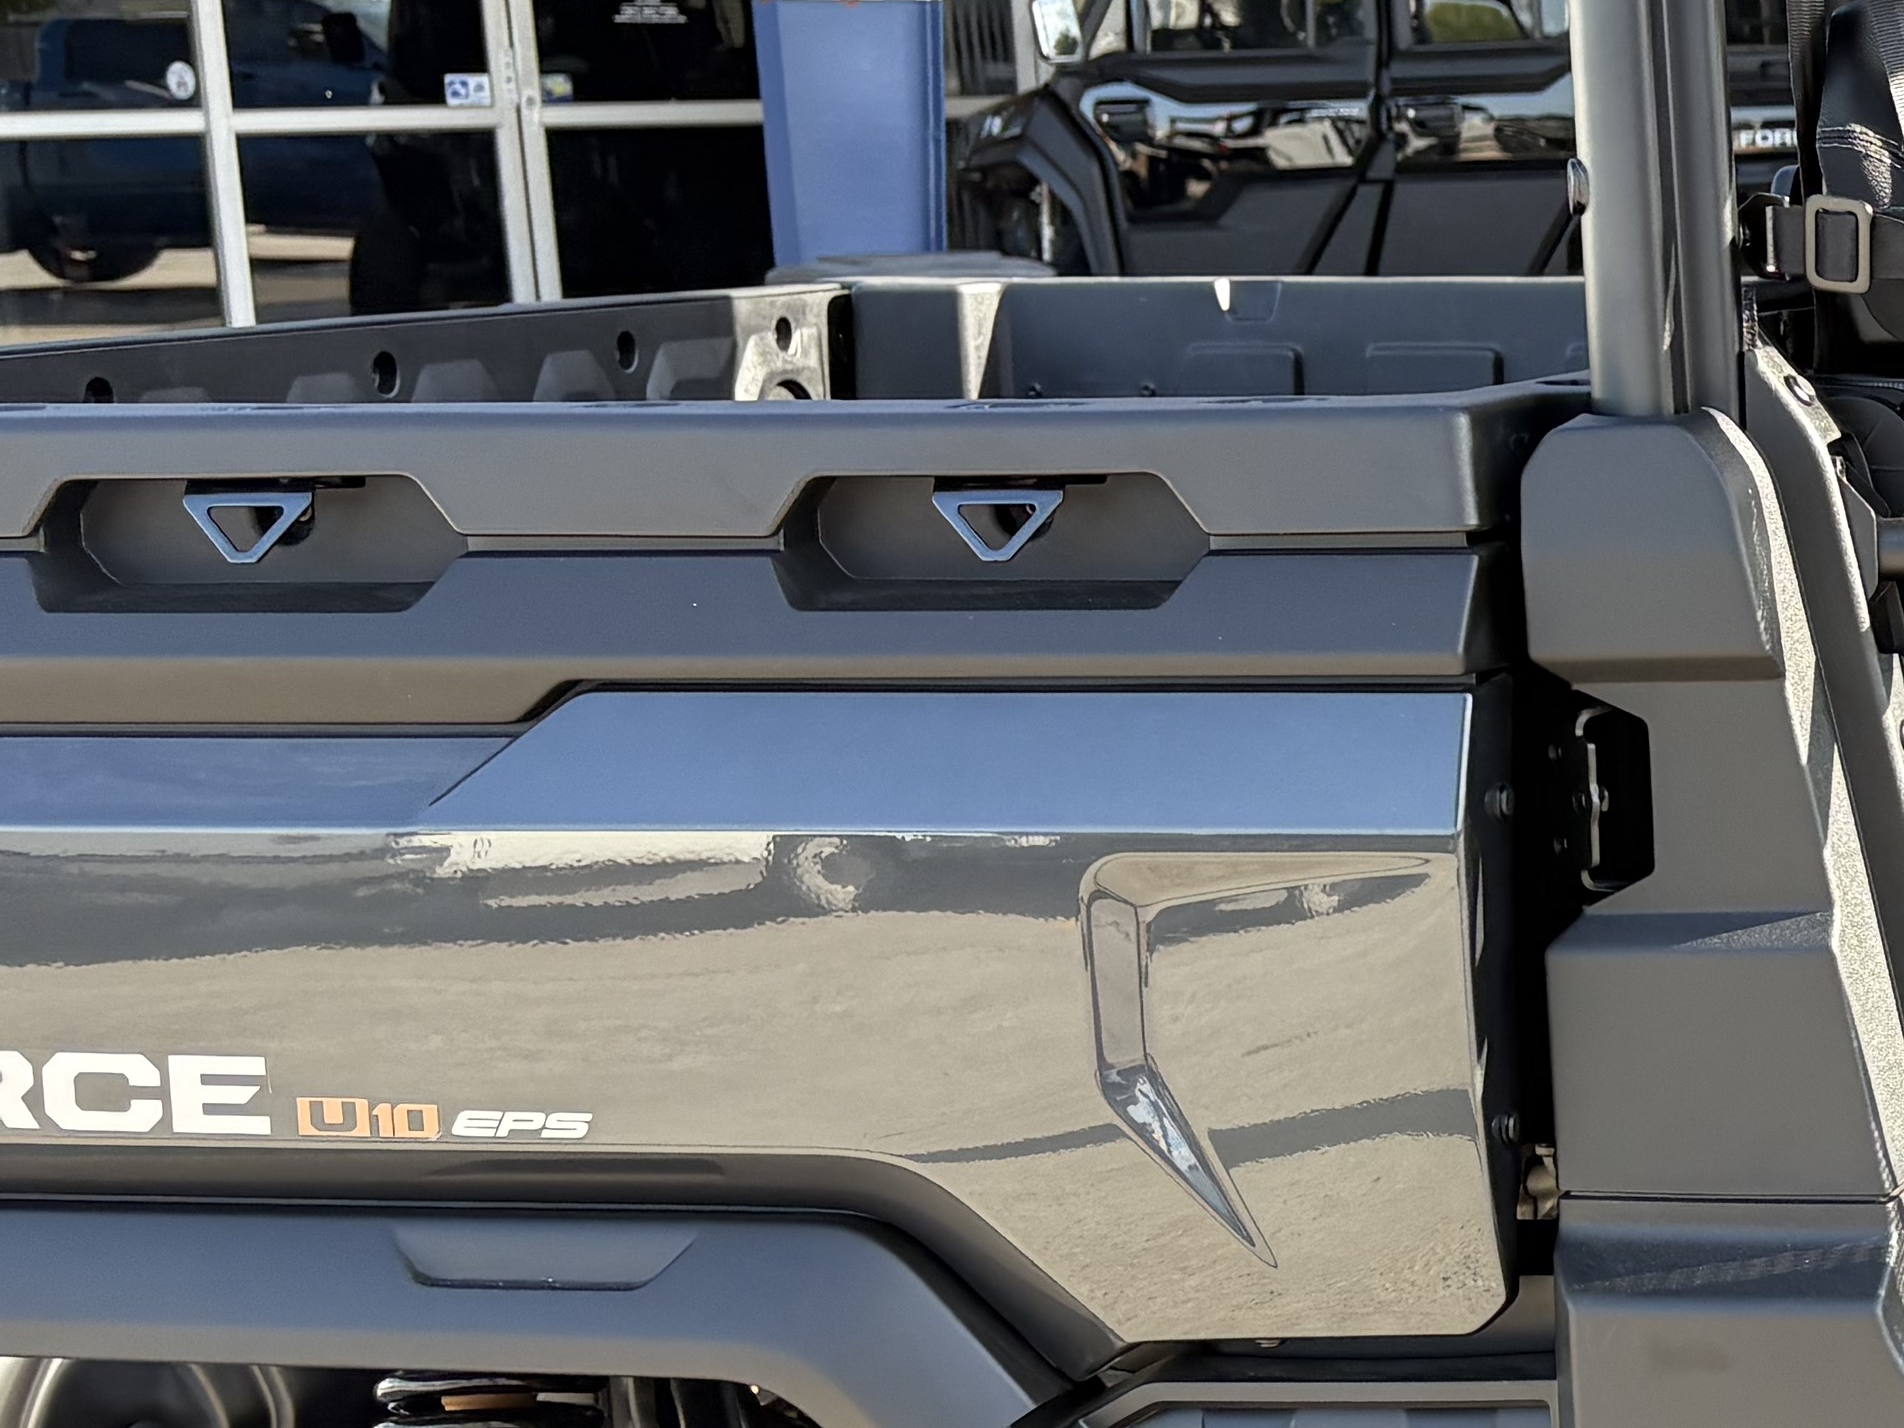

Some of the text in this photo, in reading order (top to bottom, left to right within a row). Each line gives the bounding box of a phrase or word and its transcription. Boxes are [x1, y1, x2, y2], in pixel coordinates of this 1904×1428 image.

[1739, 128, 1797, 149] FOR
[296, 1097, 441, 1140] U10
[451, 1110, 594, 1140] EPS
